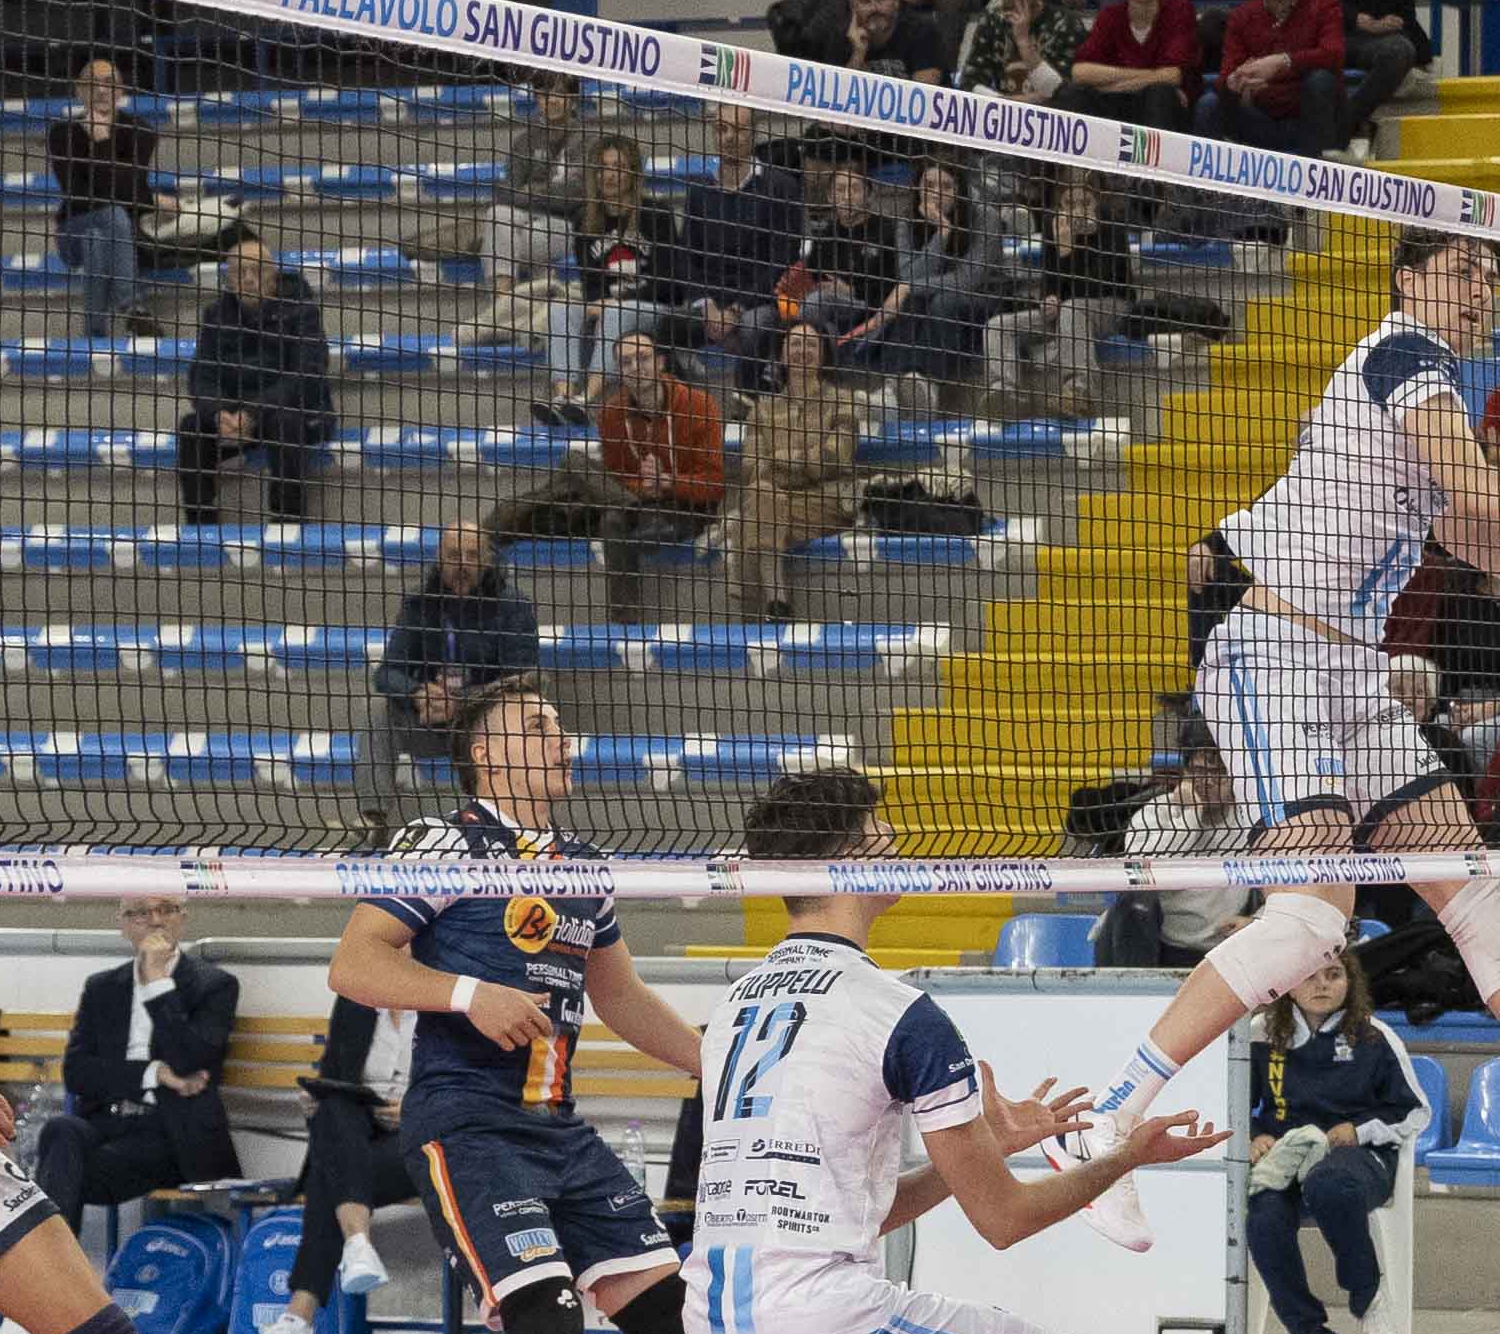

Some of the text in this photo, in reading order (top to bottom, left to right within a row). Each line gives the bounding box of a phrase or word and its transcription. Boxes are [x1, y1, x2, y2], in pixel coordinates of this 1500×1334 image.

[464, 0, 523, 52] SAN
[530, 13, 661, 76] GIUSTINO
[786, 62, 1089, 157] PALLAVOLO SAN GIUSTINO
[1188, 140, 1437, 219] PALLAVOLO SAN GIUSTINO
[336, 863, 617, 896] PALLAVOLO SAN GIUSTINO
[828, 863, 1053, 893] PALLAVOLO SAN GIUSTINO
[1222, 857, 1407, 886] PALLAVOLO SAN GIUSTINO
[728, 969, 845, 1003] FILIPPELLI
[712, 1000, 809, 1122] 12
[744, 1179, 806, 1200] FOREL
[776, 1218, 809, 1233] SPIRITS
